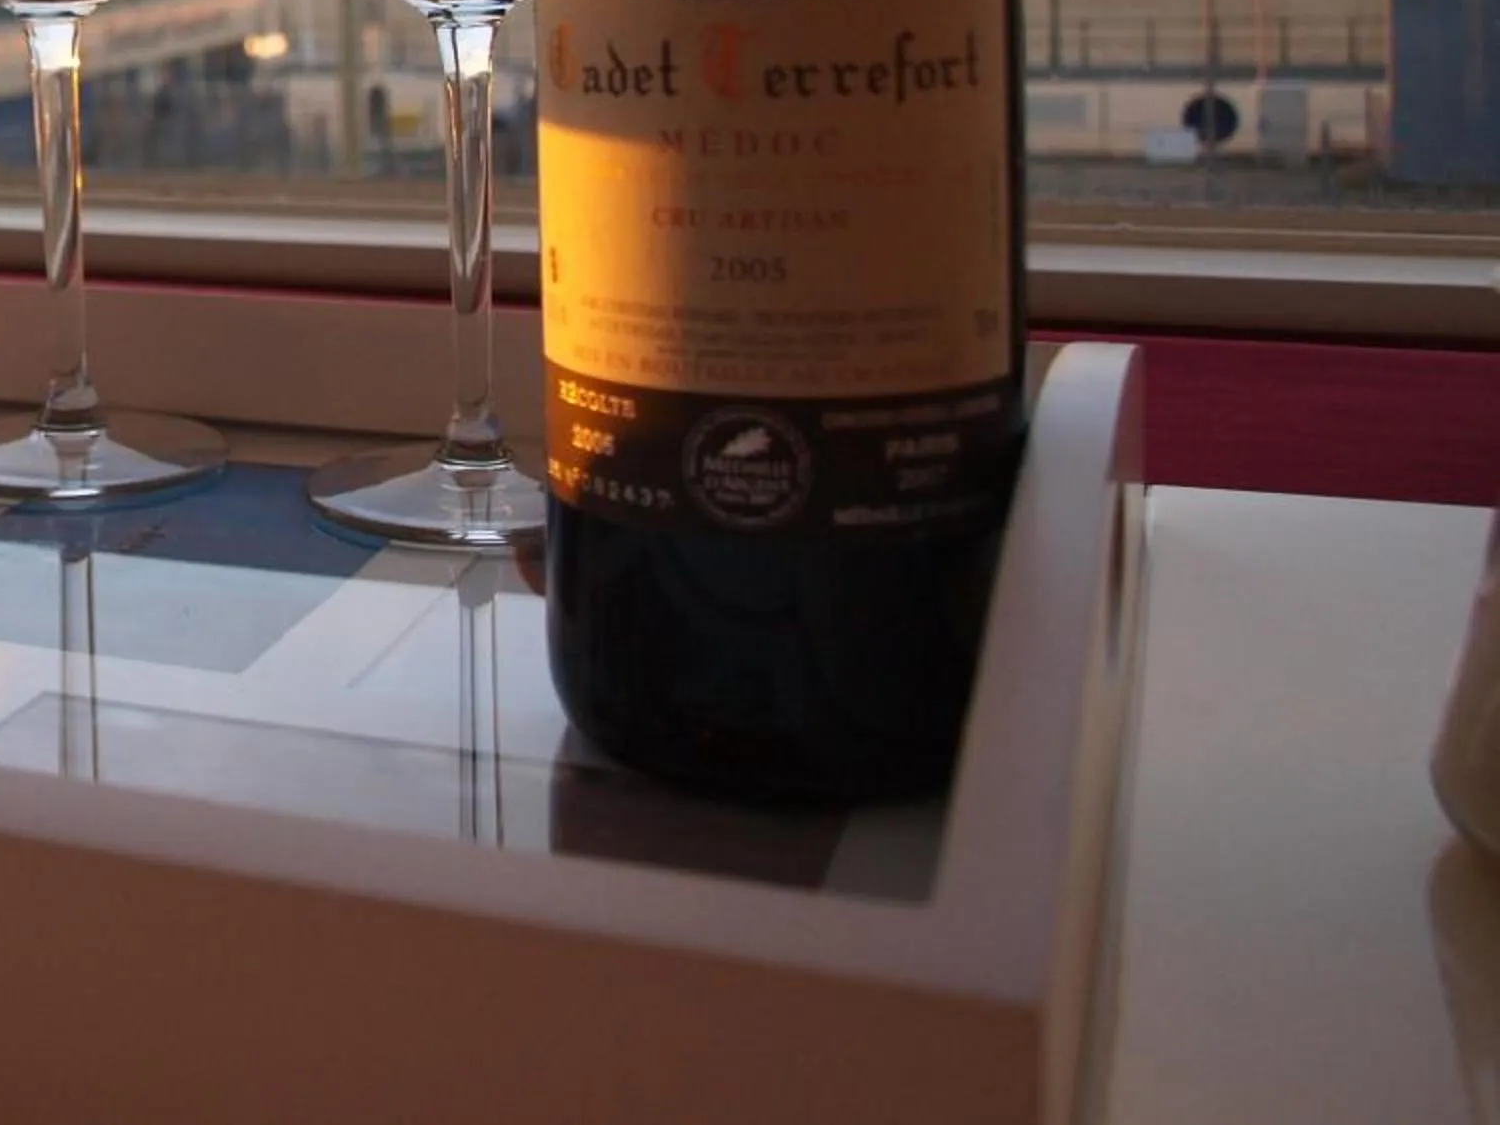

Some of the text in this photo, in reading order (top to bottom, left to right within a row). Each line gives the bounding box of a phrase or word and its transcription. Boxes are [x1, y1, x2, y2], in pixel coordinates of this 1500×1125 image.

[547, 22, 979, 104] Cadet Terrefort
[718, 207, 849, 234] ARTISAN
[709, 254, 788, 283] 2005
